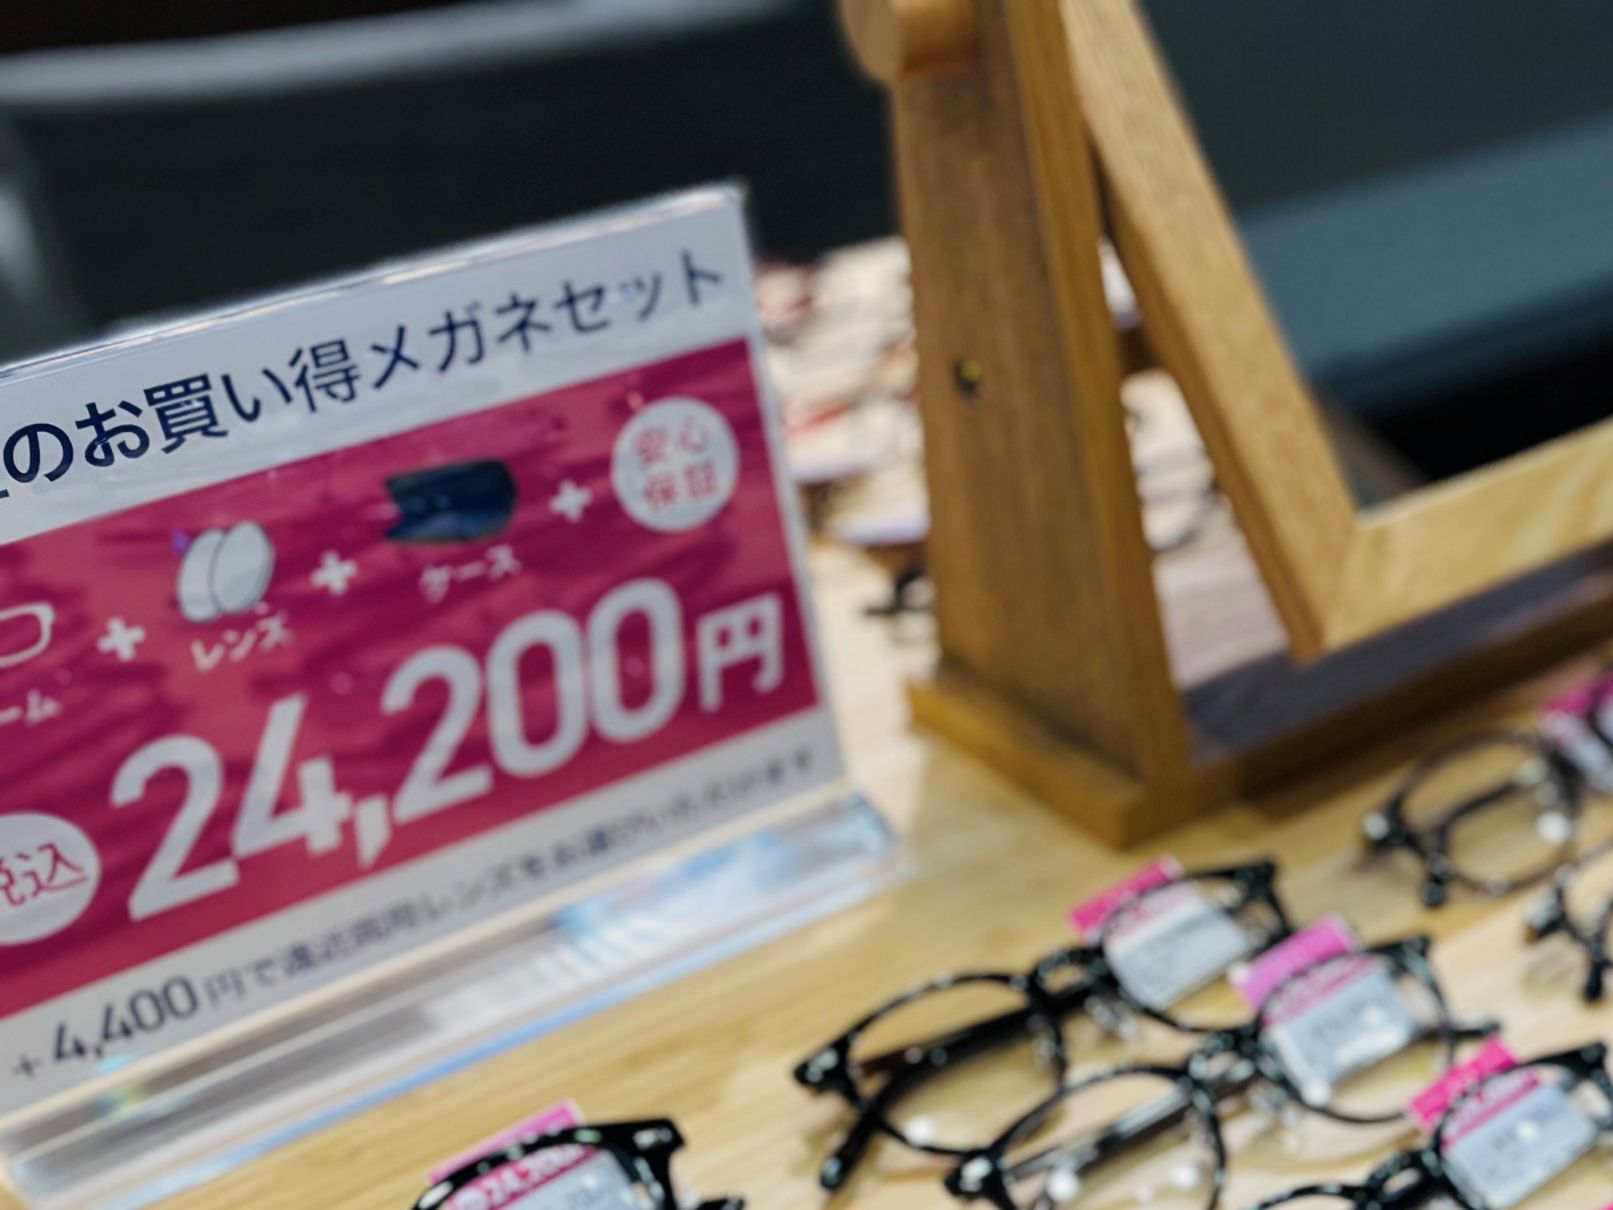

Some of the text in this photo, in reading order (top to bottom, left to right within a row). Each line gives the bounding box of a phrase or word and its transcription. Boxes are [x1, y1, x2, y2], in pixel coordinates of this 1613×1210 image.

[0, 248, 722, 499] のお買い得メガネセット
[190, 609, 295, 674] レンズ
[417, 543, 521, 603] ケース
[110, 577, 785, 921] 24,200円
